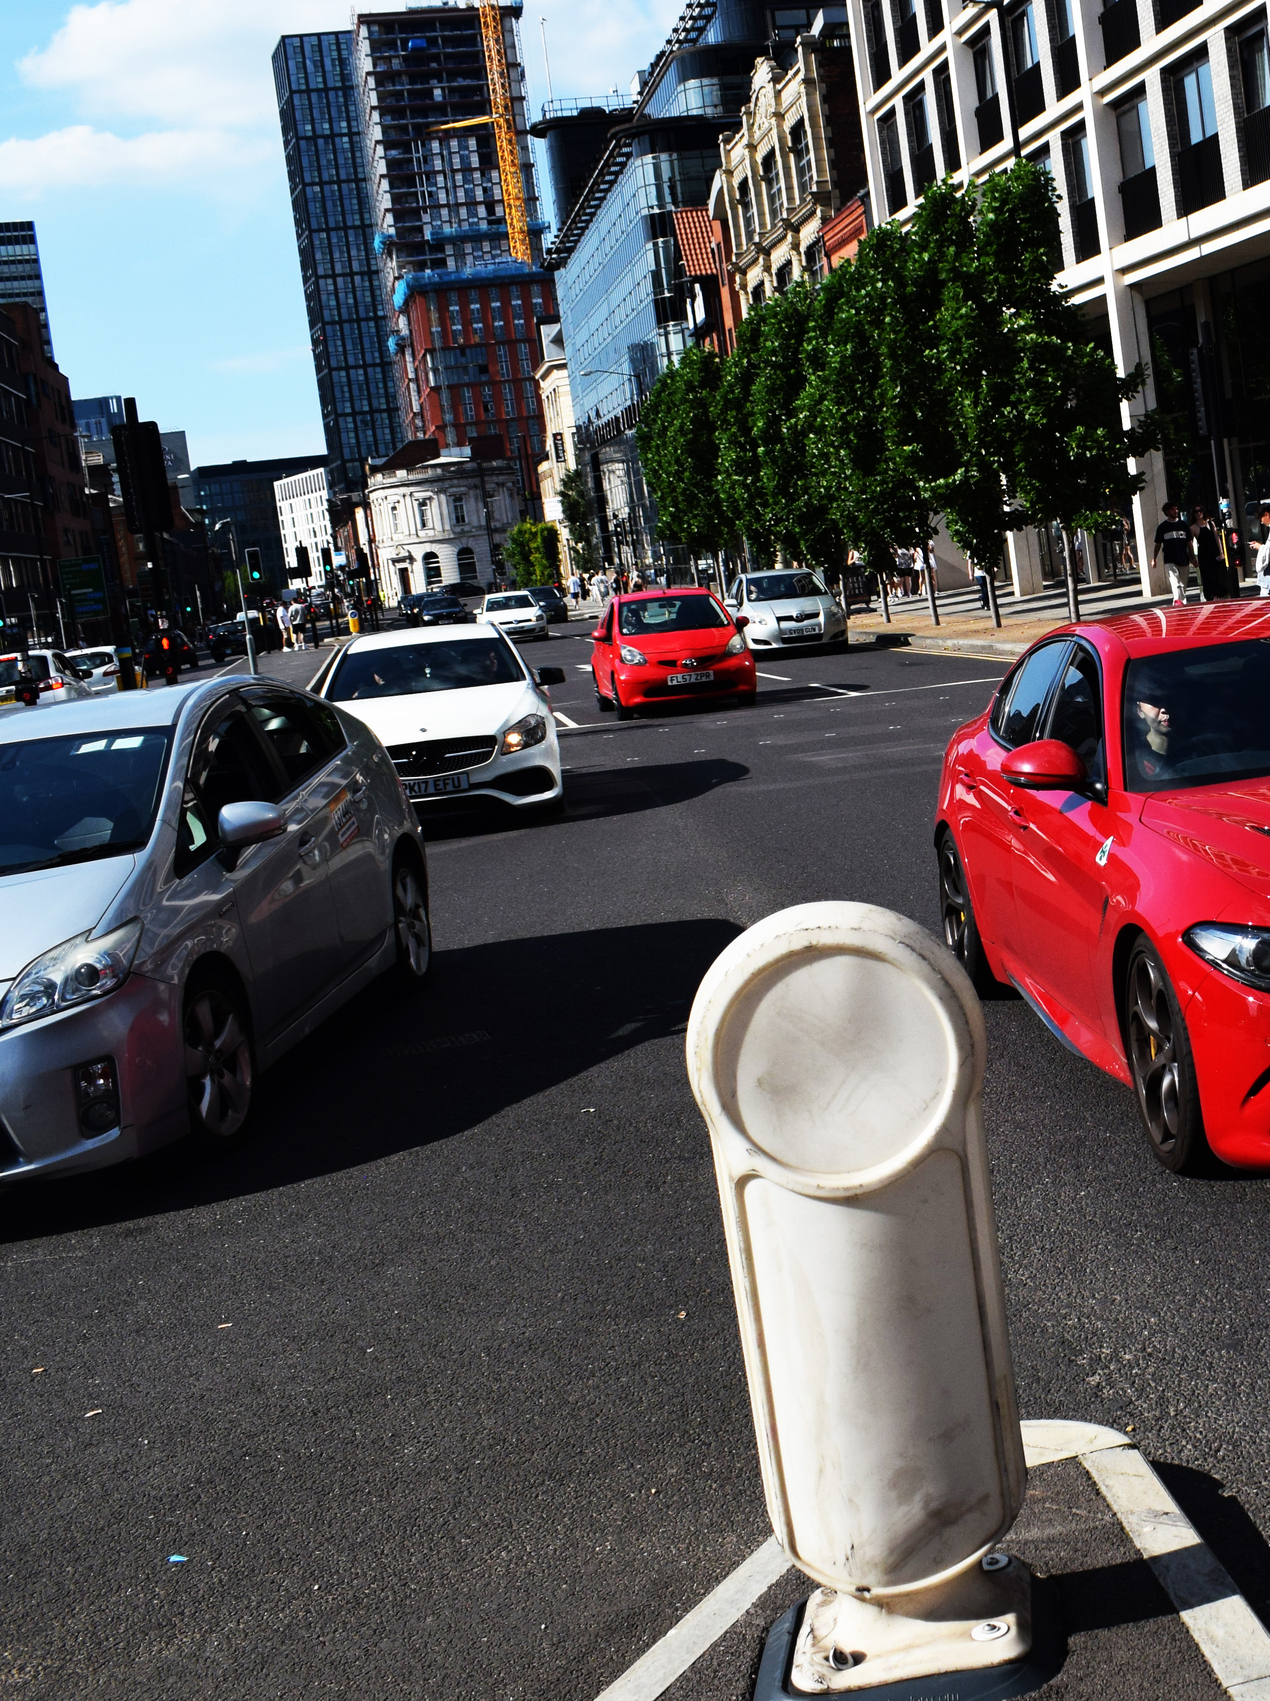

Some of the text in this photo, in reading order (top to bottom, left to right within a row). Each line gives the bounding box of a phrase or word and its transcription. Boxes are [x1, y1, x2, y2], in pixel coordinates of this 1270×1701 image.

[669, 671, 712, 684] FL57 ZPR
[433, 777, 462, 792] EFU
